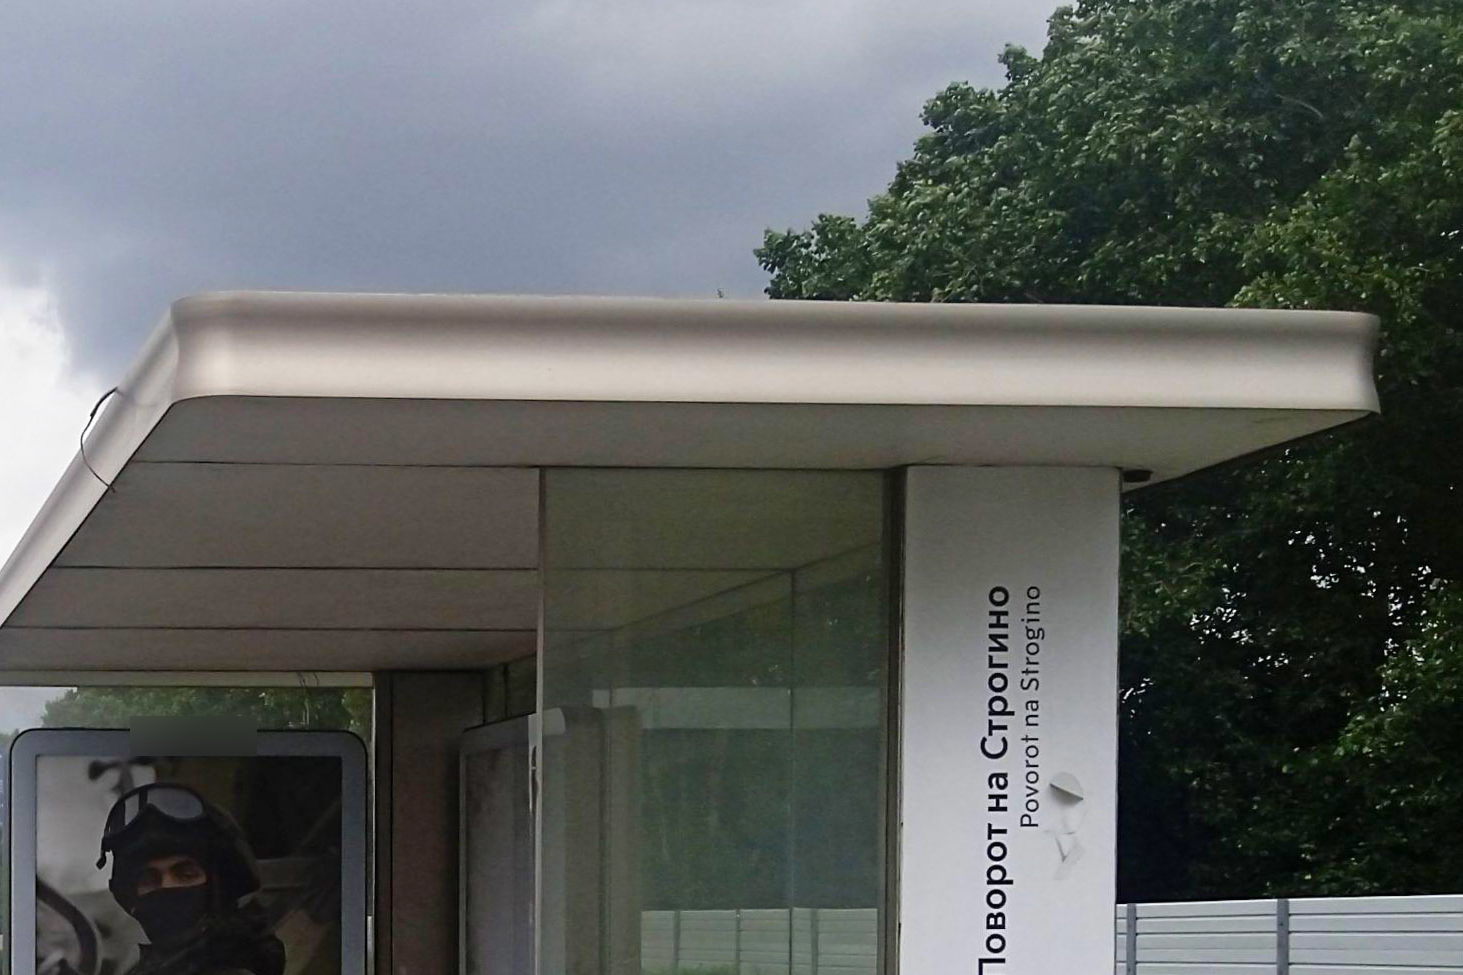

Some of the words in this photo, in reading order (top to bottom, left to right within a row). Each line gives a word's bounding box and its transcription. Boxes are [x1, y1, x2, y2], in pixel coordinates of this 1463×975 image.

[980, 585, 1015, 760] Строгино
[1020, 585, 1045, 691] Strogino
[1025, 699, 1040, 727] na
[987, 771, 1009, 813] на
[1020, 734, 1040, 828] Povorot
